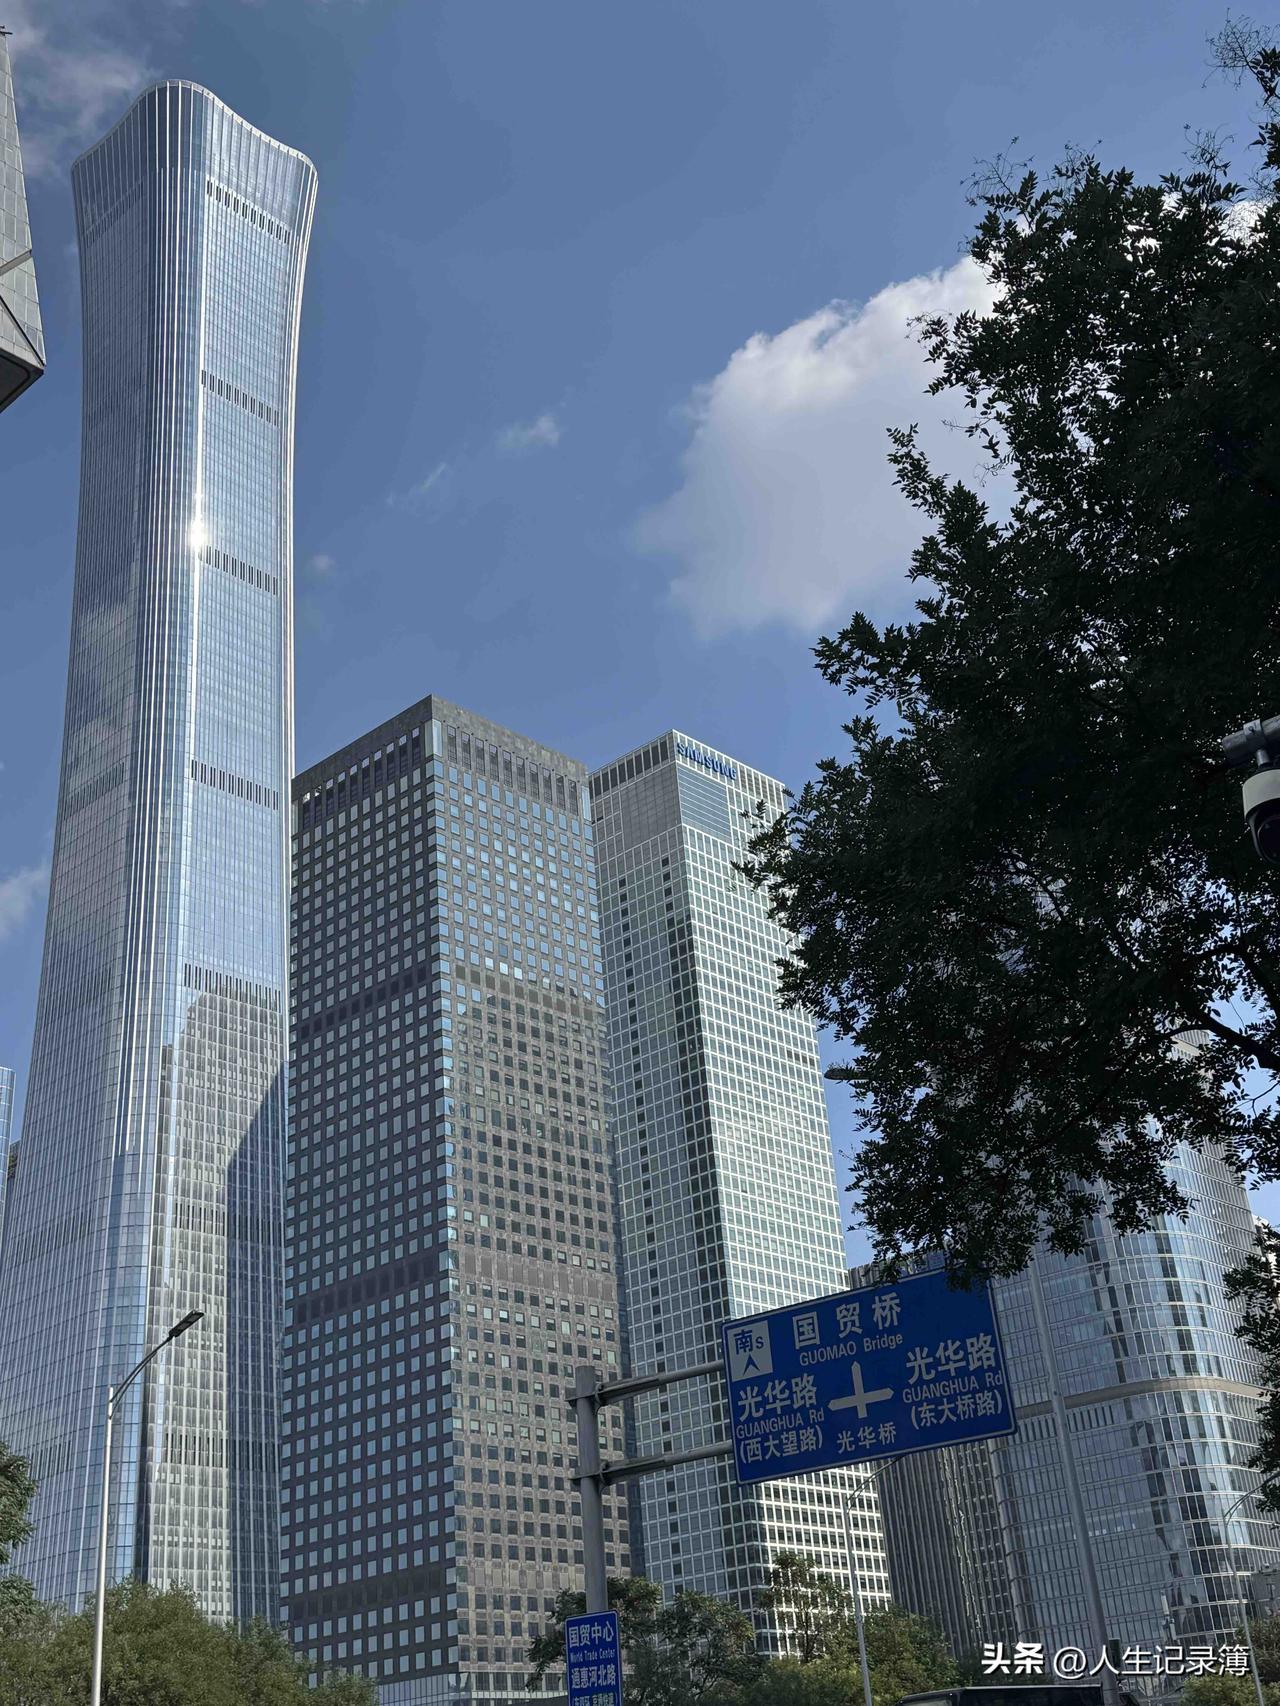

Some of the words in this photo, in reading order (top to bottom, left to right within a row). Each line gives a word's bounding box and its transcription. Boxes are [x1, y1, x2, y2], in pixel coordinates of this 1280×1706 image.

[677, 742, 737, 780] SAMSUNG
[793, 1292, 902, 1349] 国贸桥
[800, 1341, 857, 1367] GUOMAO
[863, 1332, 904, 1353] Bridge
[905, 1333, 997, 1385] 光华路
[737, 1373, 818, 1422] 光华路
[902, 1377, 978, 1404] GUANGHUA
[985, 1371, 1004, 1387] Rd
[735, 1415, 803, 1440] GUANGHUA
[809, 1408, 825, 1424] Rd
[910, 1389, 1003, 1431] (东大桥路)
[739, 1425, 824, 1465] (西大望路)
[837, 1422, 897, 1454] 光华桥
[568, 1620, 615, 1648] 国贸中心
[584, 1650, 598, 1661] Trade
[599, 1648, 616, 1659] Center
[571, 1663, 616, 1689] 通惠河北路
